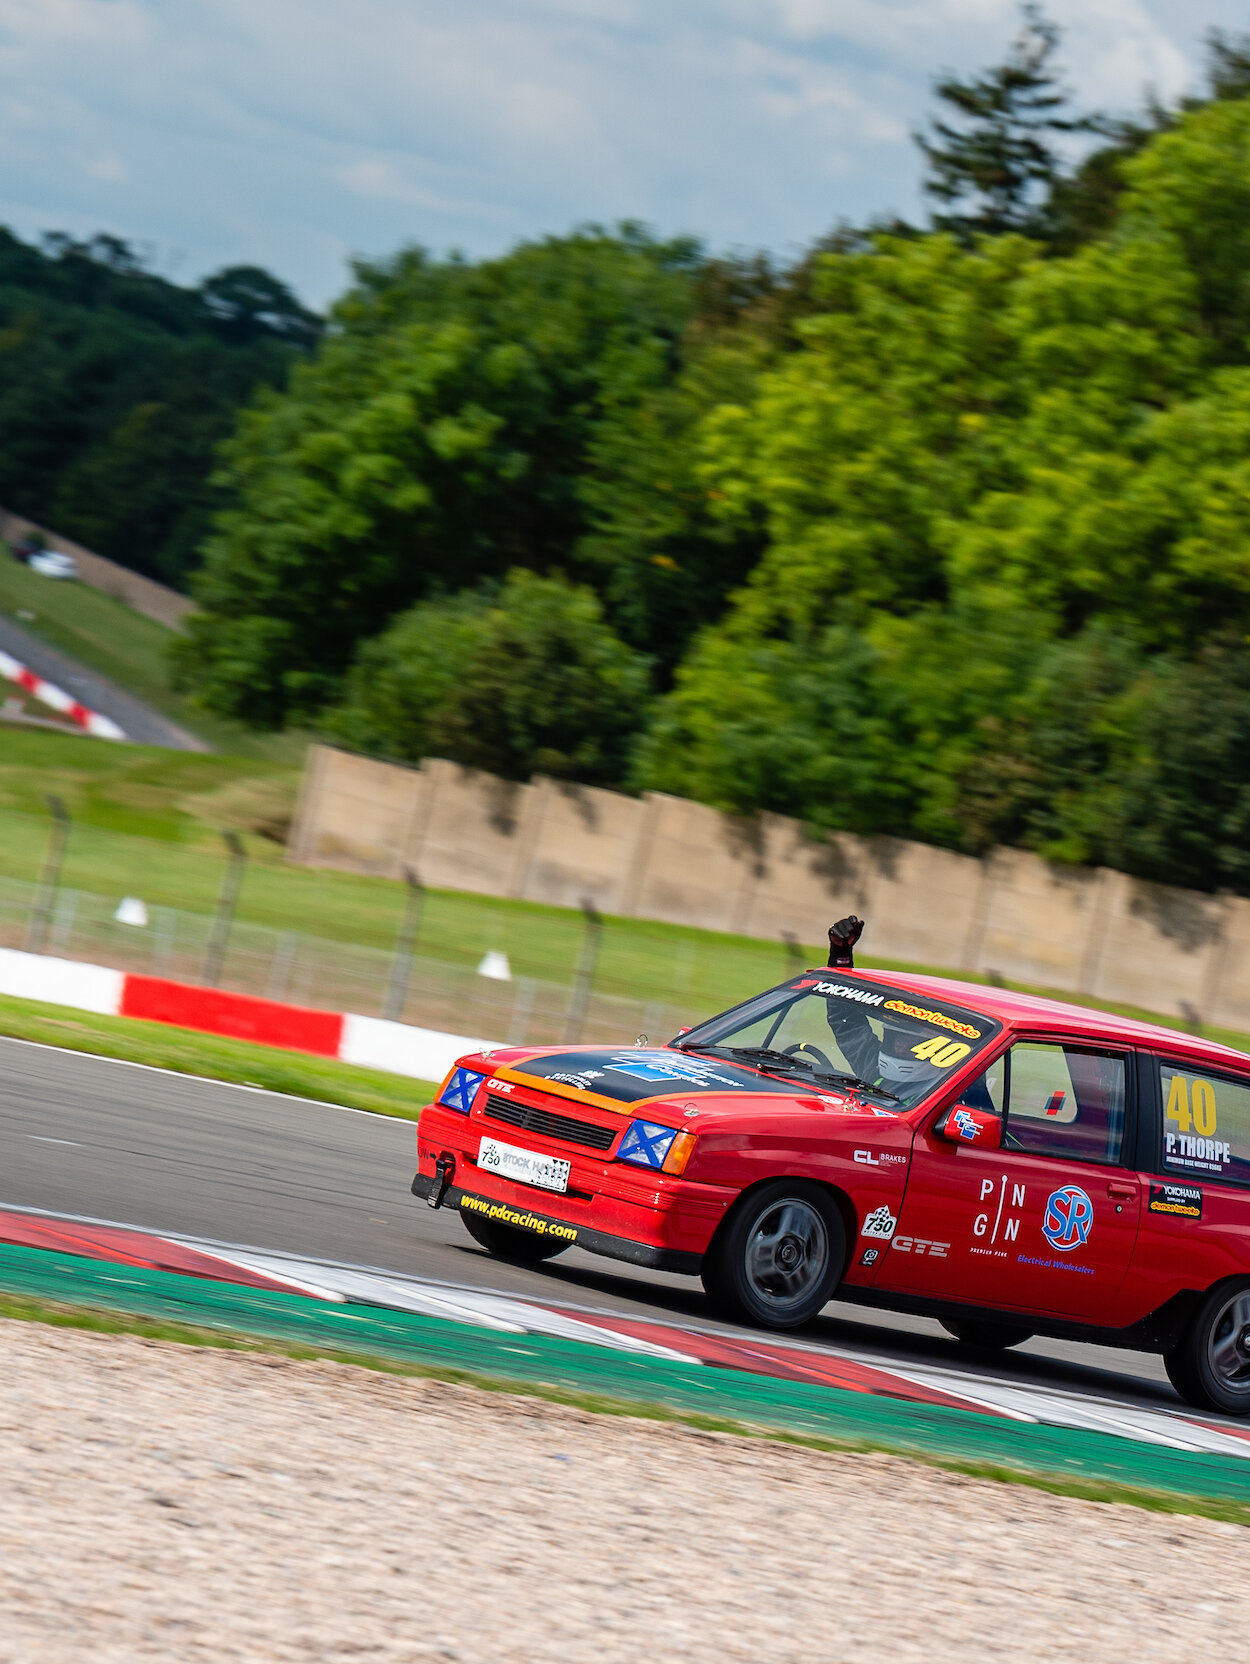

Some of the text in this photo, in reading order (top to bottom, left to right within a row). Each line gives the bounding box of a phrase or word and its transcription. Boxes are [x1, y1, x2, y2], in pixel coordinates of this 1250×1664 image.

[813, 981, 982, 1039] YOKOHAMA demon tweeks
[910, 1035, 972, 1068] 40
[486, 1079, 516, 1093] GTE
[1166, 1075, 1217, 1137] 40
[854, 1150, 880, 1165] CL
[880, 1153, 907, 1164] BRAKES
[1166, 1132, 1177, 1154] P.
[1179, 1134, 1231, 1164] THORPE
[1163, 1184, 1201, 1200] YOKOHAMA
[460, 1194, 578, 1241] www.pdcracing.com
[865, 1217, 894, 1233] 750
[1041, 1188, 1094, 1244] SR
[891, 1235, 951, 1258] GTE
[1017, 1254, 1095, 1275] Electrical Wholesalers
